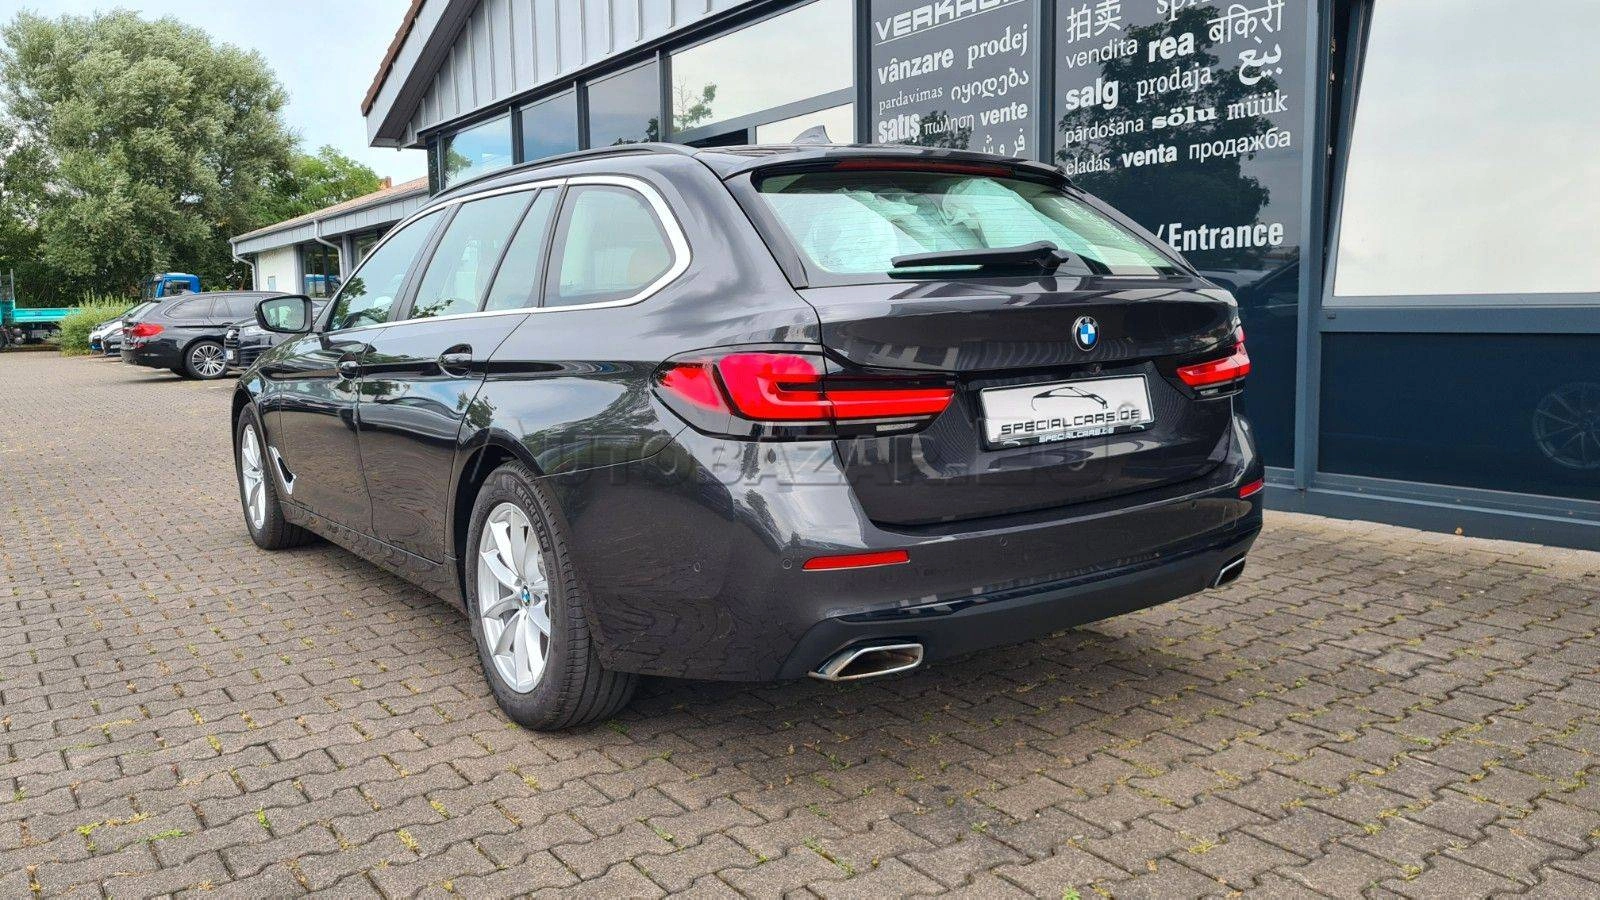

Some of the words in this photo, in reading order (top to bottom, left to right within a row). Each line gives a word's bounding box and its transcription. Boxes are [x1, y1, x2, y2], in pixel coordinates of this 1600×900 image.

[1066, 0, 1122, 43] 拍卖
[877, 48, 955, 85] vânzare
[966, 23, 1028, 70] prodej
[1065, 38, 1138, 69] vendita
[1148, 31, 1195, 63] rea
[1238, 43, 1283, 86] بيع
[878, 86, 944, 115] pardavimas
[950, 67, 1029, 104] იყიდება
[1065, 77, 1119, 111] salg
[1136, 62, 1213, 103] prodaja
[878, 112, 921, 143] satış
[923, 113, 975, 136] πώληση
[979, 101, 1028, 127] vente
[1065, 117, 1144, 148] pārdošana
[1152, 105, 1218, 130] sölu
[1227, 89, 1288, 121] müük
[1065, 154, 1111, 177] eladás
[1121, 144, 1178, 168] venta
[1188, 126, 1291, 163] продажба
[1001, 409, 1140, 435] SPECIALCARS.DE
